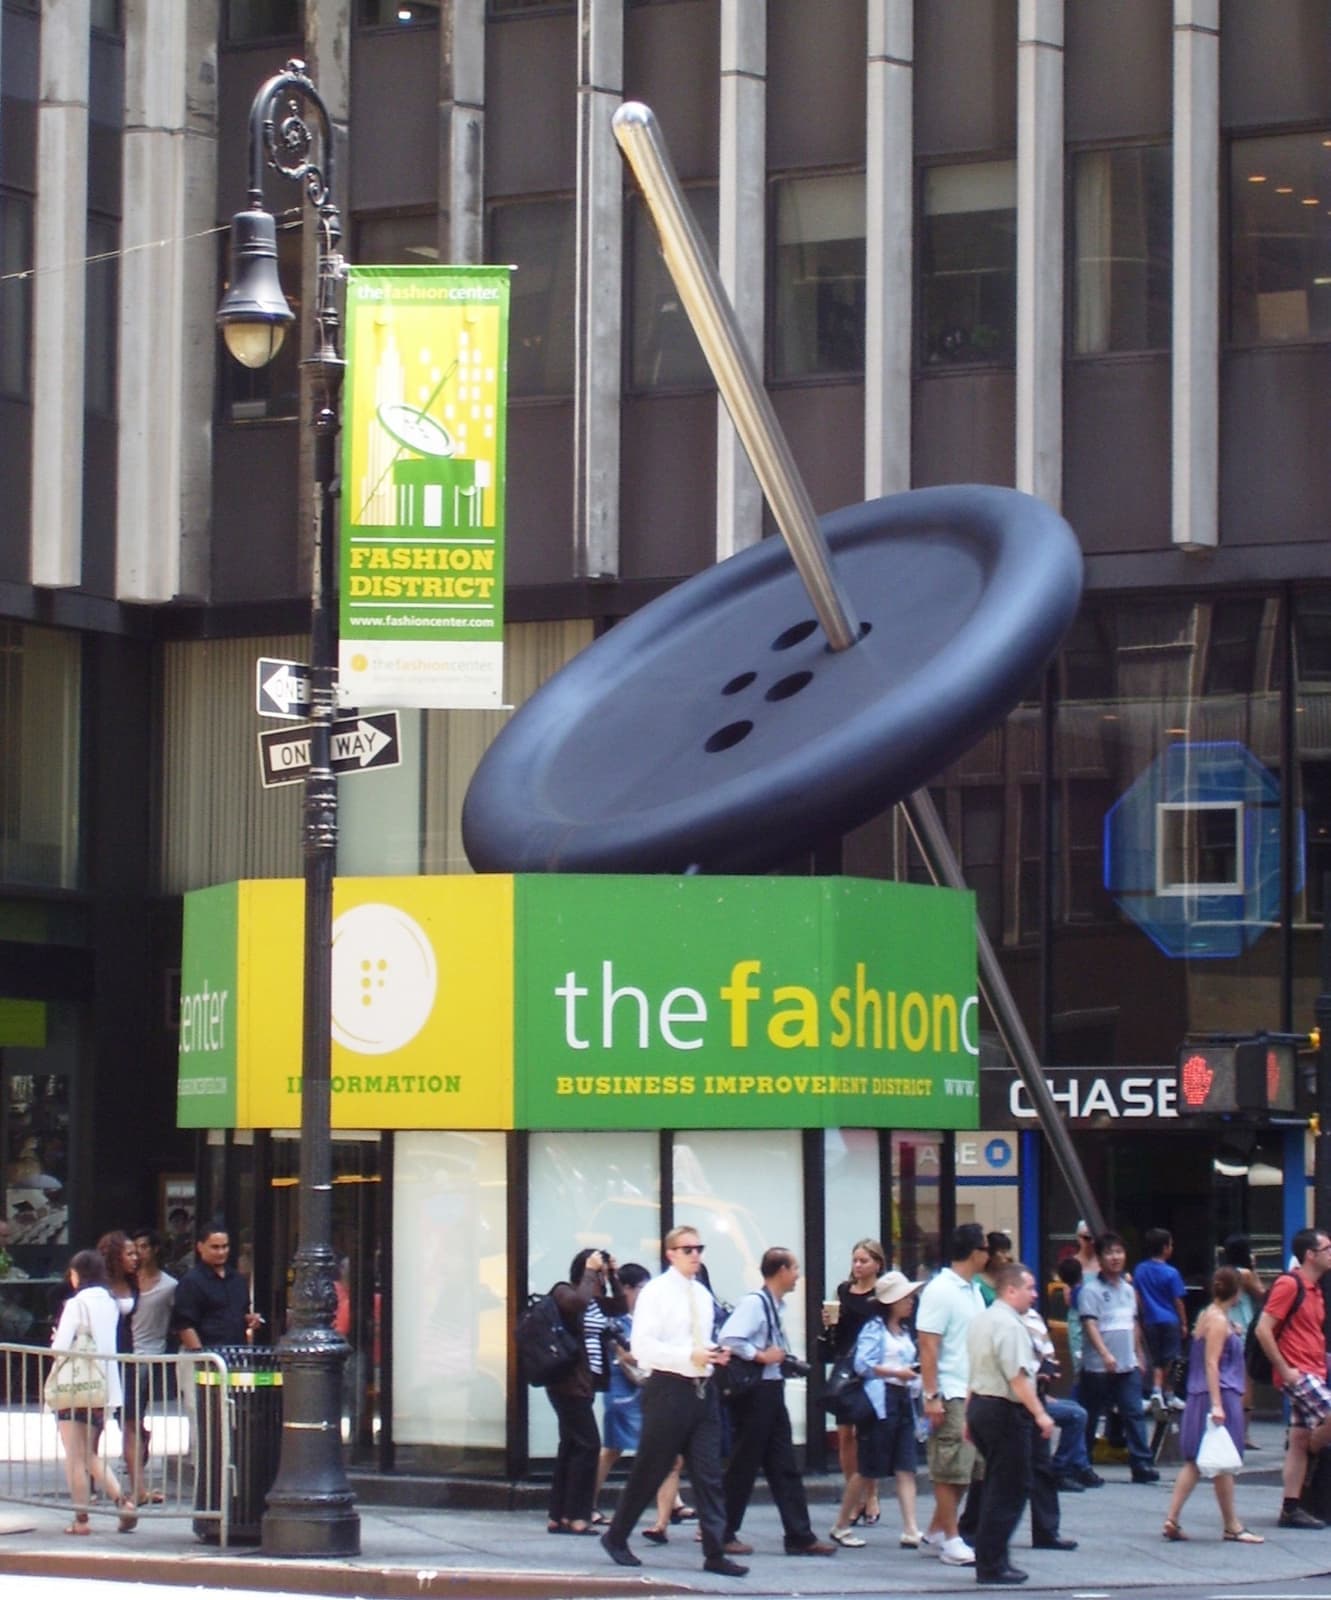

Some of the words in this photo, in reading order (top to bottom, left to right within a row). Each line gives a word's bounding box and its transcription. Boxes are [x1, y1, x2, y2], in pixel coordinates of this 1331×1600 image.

[349, 547, 495, 571] FASHION
[349, 575, 495, 598] DISTRICT
[349, 614, 495, 627] www.fashioncenter.com
[281, 744, 307, 766] ON
[336, 732, 376, 757] WAY
[178, 979, 228, 1052] enter
[287, 1075, 461, 1094] IORMATION
[556, 1076, 696, 1096] BUSINESS
[704, 1075, 868, 1096] IMPROVEMENT
[872, 1078, 933, 1097] DISTRICT
[1009, 1078, 1180, 1118] CHASE
